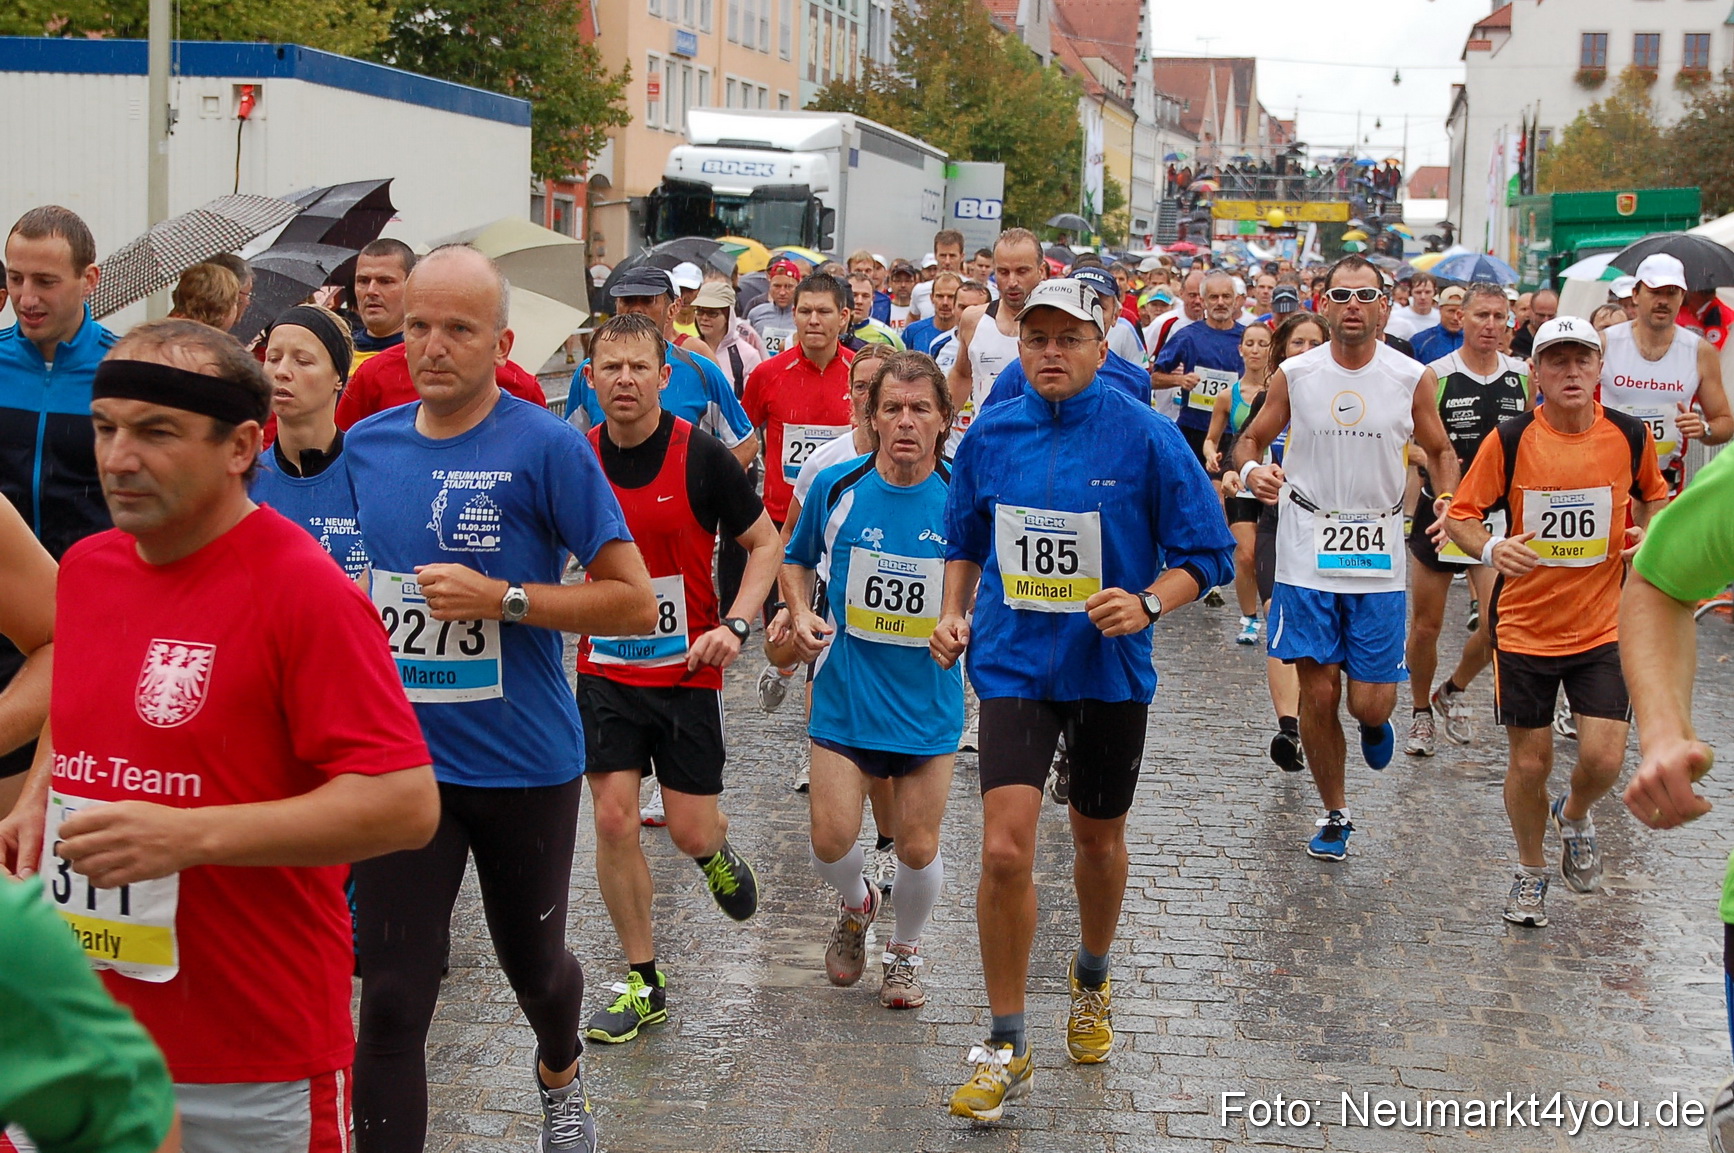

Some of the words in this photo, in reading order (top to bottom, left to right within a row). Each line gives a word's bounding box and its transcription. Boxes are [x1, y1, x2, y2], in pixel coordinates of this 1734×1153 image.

[702, 159, 776, 177] BOCK
[766, 336, 785, 351] 23
[1614, 375, 1684, 392] Oberbank
[790, 441, 828, 464] 23
[432, 470, 446, 480] 12.
[447, 471, 512, 482] NEUMARKTER
[443, 480, 496, 490] STADTLAUF
[1550, 494, 1586, 504] BOCK
[309, 517, 323, 526] 12.
[457, 523, 501, 532] 18.09.2011
[1025, 515, 1066, 529] BOCK
[1541, 510, 1595, 538] 206
[1322, 526, 1385, 551] 2264
[1015, 535, 1079, 575] 185
[1551, 545, 1585, 556] Xaver
[878, 559, 918, 572] BOCK
[1339, 556, 1372, 567] Tobias
[864, 575, 925, 615] 638
[1016, 580, 1073, 598] Michael
[875, 616, 905, 632] Rudi
[617, 643, 656, 657] Oliver
[403, 665, 457, 684] Marco
[66, 920, 121, 959] harly
